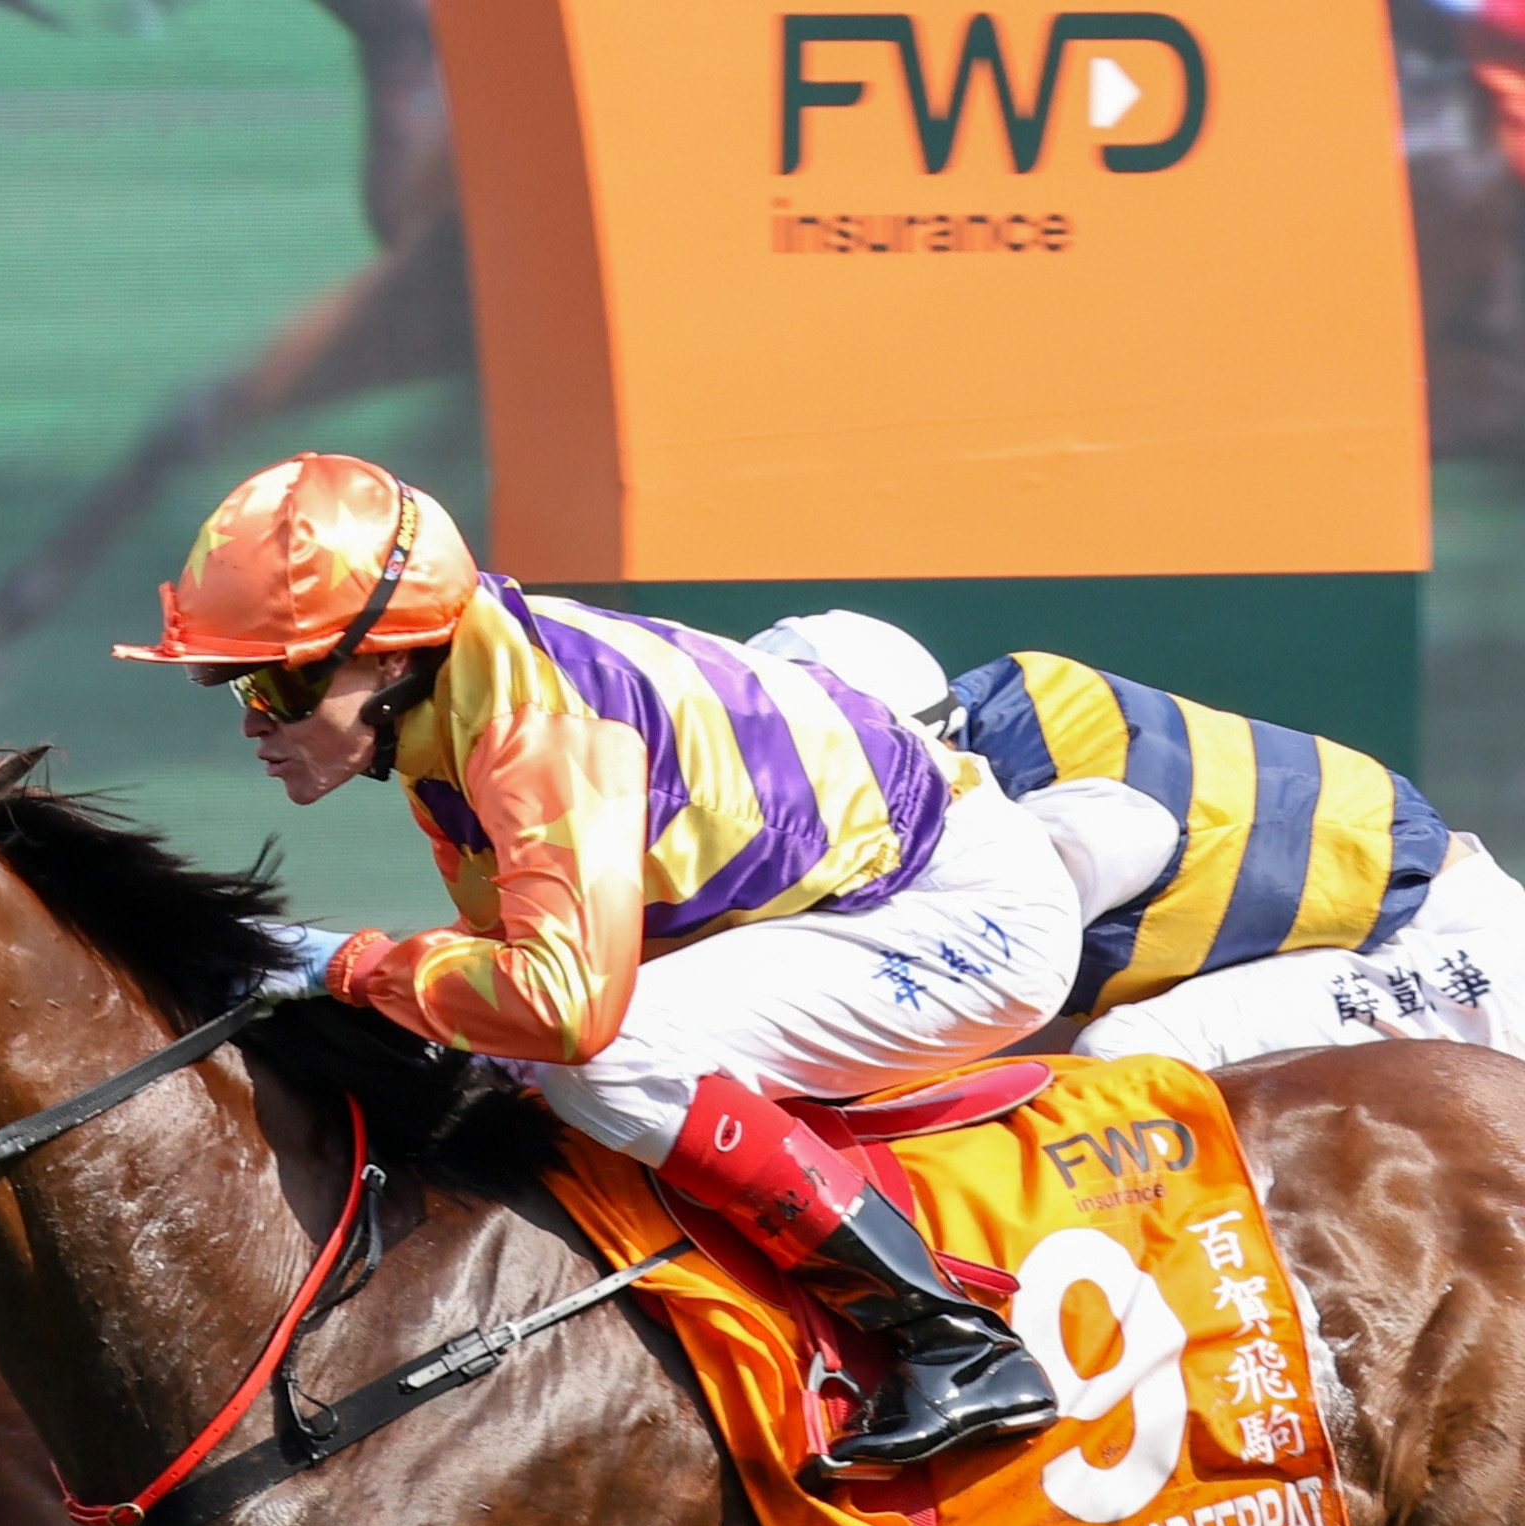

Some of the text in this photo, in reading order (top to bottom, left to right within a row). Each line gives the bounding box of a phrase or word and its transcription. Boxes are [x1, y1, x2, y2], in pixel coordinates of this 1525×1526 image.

[781, 12, 1209, 174] FWD
[771, 196, 1074, 253] insurance
[1041, 1119, 1195, 1188] FWD
[1072, 1183, 1166, 1214] insurance
[1011, 1228, 1188, 1523] 9
[1185, 1210, 1307, 1465] 百賀飛駒
